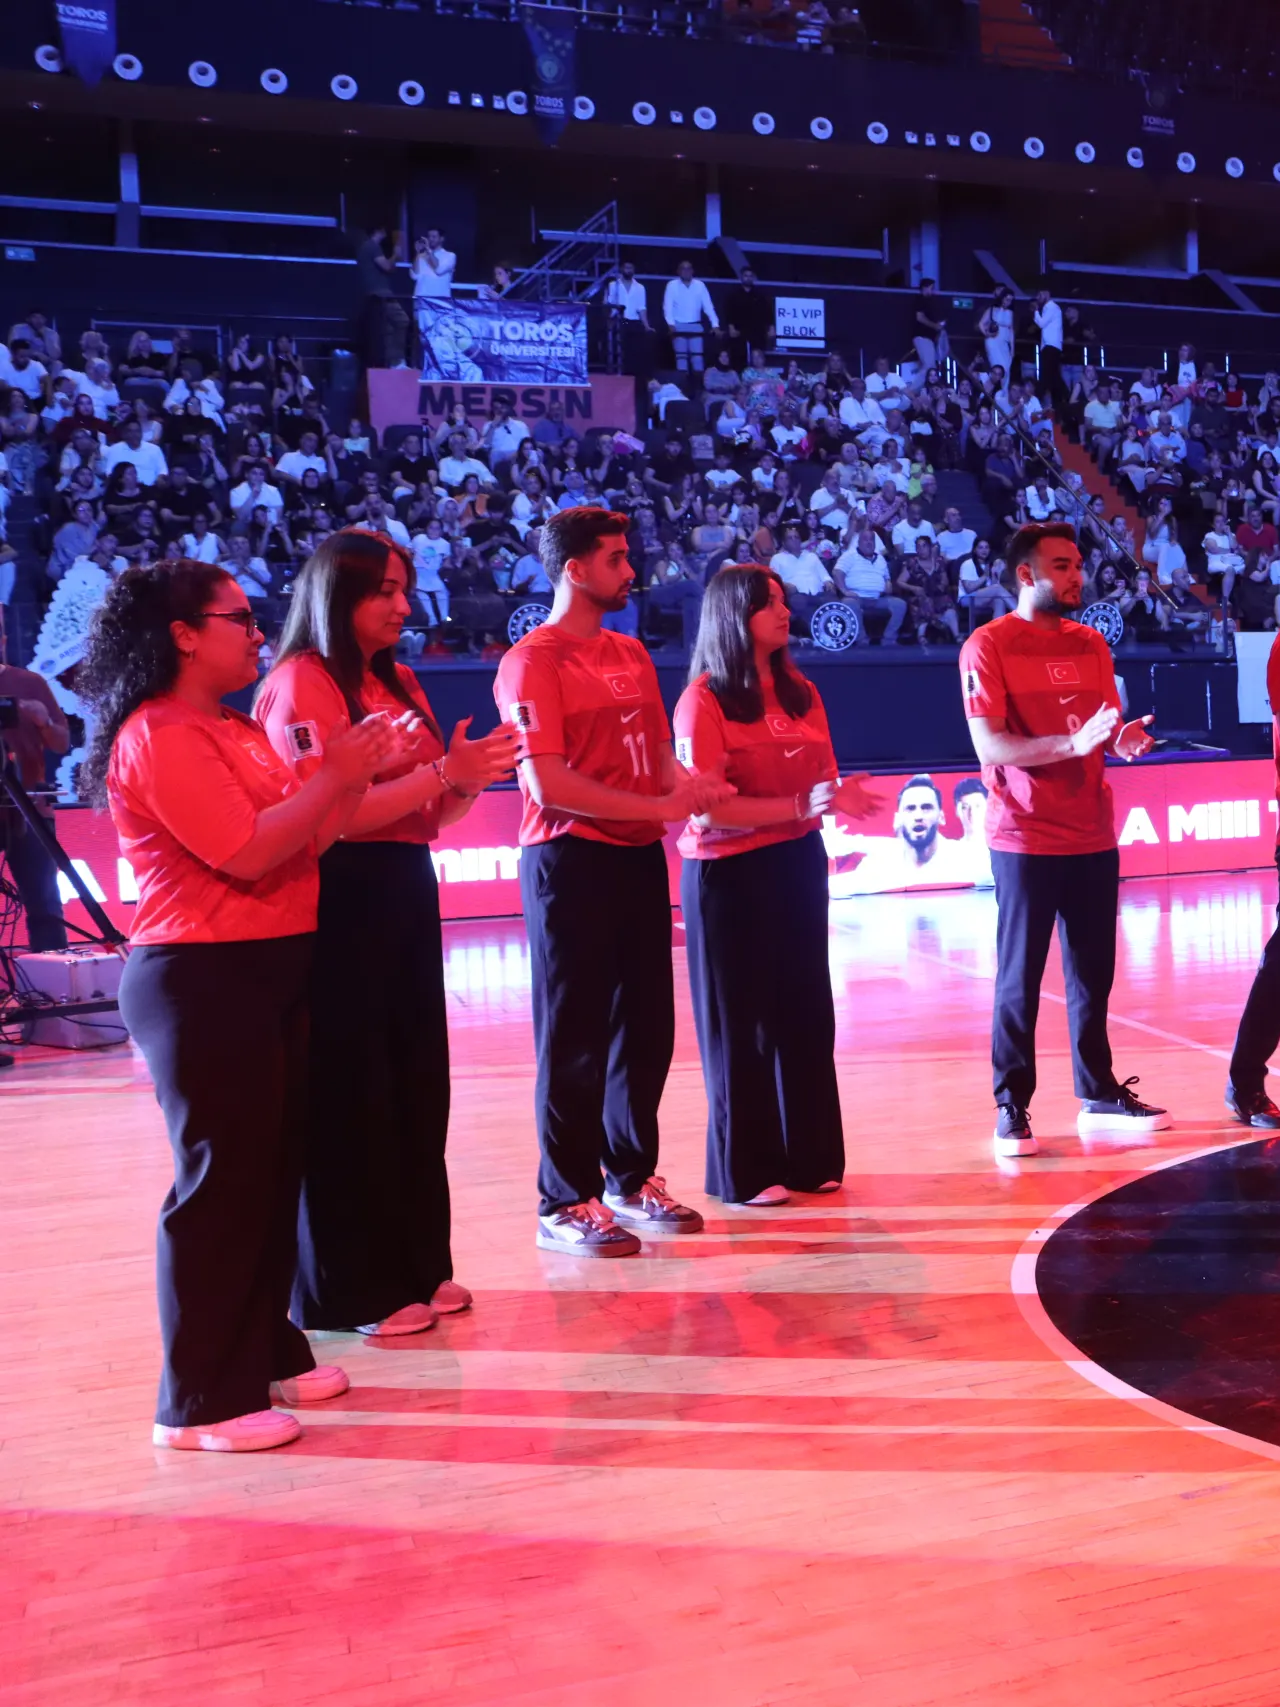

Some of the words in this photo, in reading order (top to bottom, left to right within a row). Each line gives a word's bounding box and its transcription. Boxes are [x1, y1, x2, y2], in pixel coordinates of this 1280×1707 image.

[56, 3, 108, 21] TOROS
[777, 307, 798, 318] R-1
[801, 309, 822, 319] VIP
[489, 320, 574, 342] TOROS
[783, 325, 818, 337] BLOK
[622, 732, 651, 777] 11
[1118, 807, 1160, 845] A
